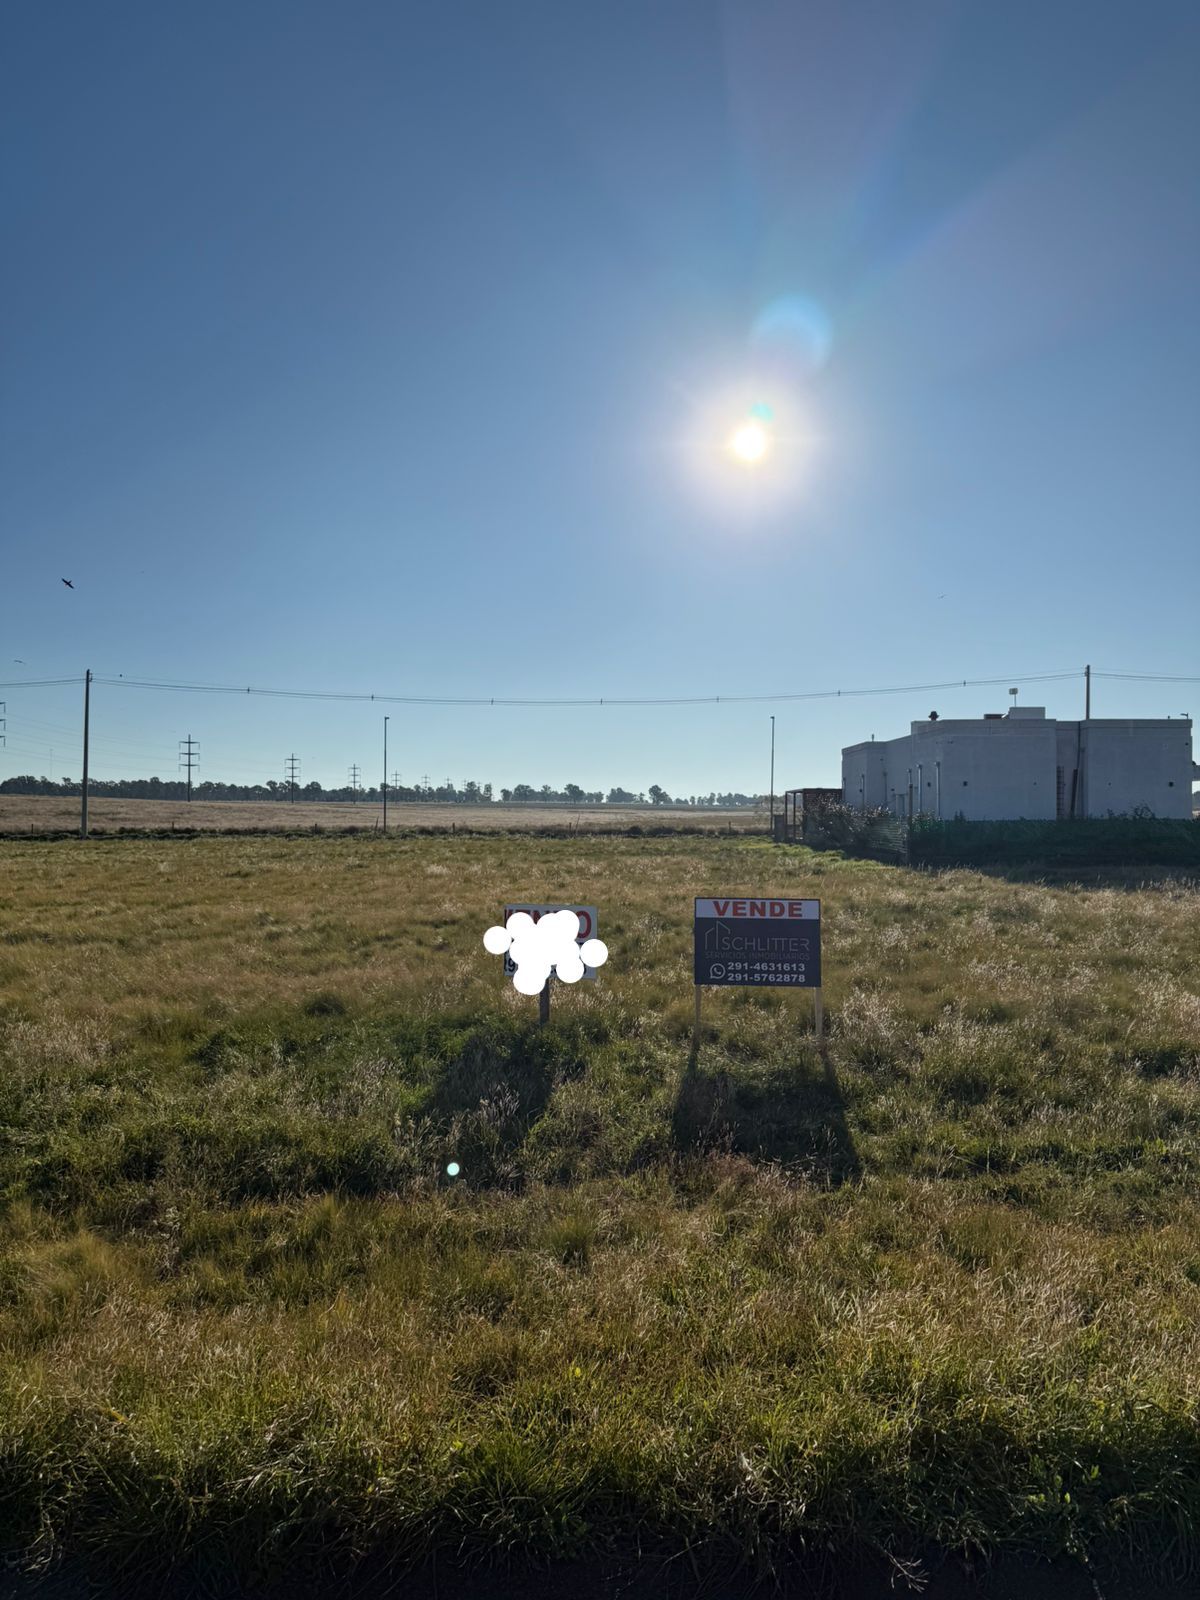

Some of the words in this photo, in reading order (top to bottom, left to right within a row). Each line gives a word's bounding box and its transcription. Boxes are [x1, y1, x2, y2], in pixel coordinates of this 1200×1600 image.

[712, 901, 803, 918] VENDE
[721, 936, 810, 952] SCHLITTER
[727, 962, 806, 972] 291-4631613
[727, 973, 806, 983] 291-5762878
